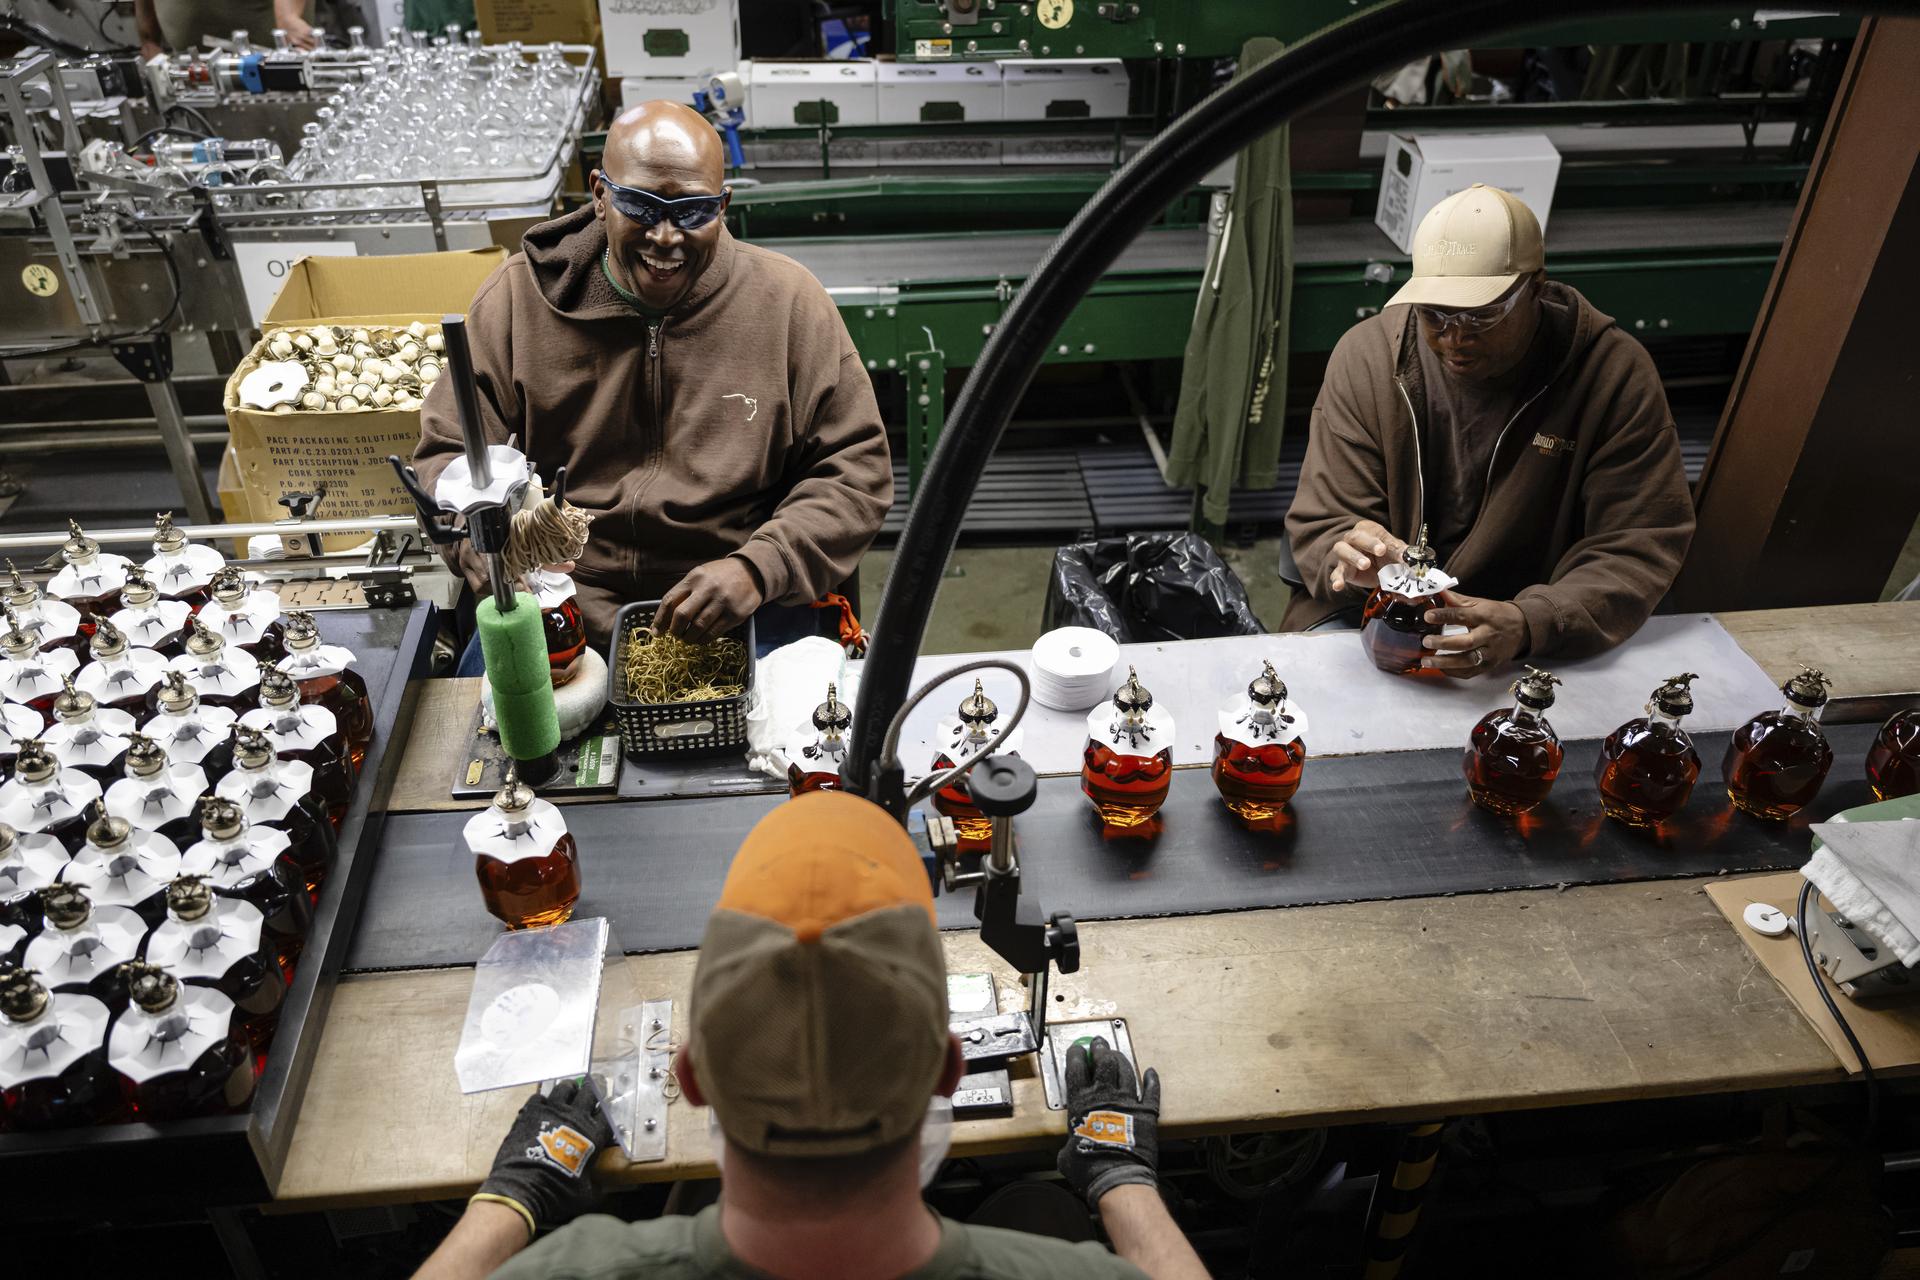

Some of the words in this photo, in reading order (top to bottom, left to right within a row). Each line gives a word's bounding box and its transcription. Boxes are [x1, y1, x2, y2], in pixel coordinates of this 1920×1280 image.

[266, 436, 289, 444] PACE
[293, 436, 349, 444] PACKAGING
[273, 458, 295, 466] PART
[300, 458, 359, 467] DESCRIPTION
[288, 469, 312, 478] CORK
[316, 469, 356, 477] STOPPER
[361, 488, 376, 497] 192
